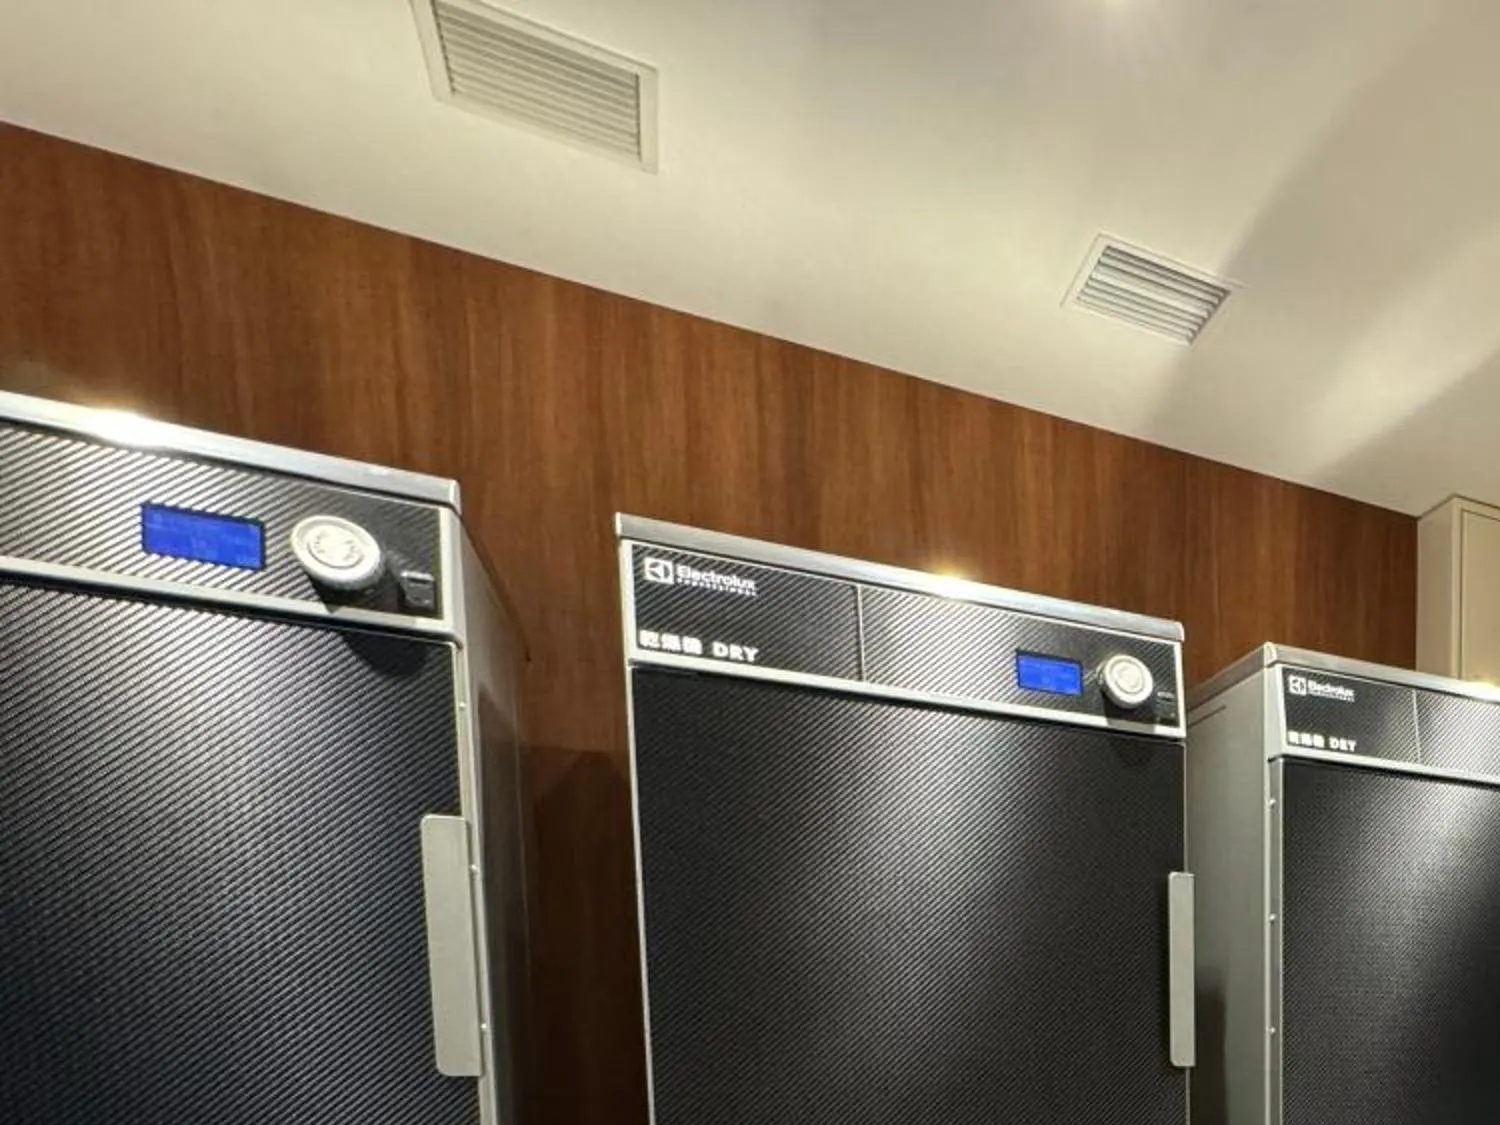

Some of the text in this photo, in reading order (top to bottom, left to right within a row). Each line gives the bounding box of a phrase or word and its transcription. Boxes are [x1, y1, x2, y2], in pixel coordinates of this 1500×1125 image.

[677, 564, 757, 590] Electrolux
[712, 641, 759, 662] DRY
[1329, 736, 1357, 752] DRY
